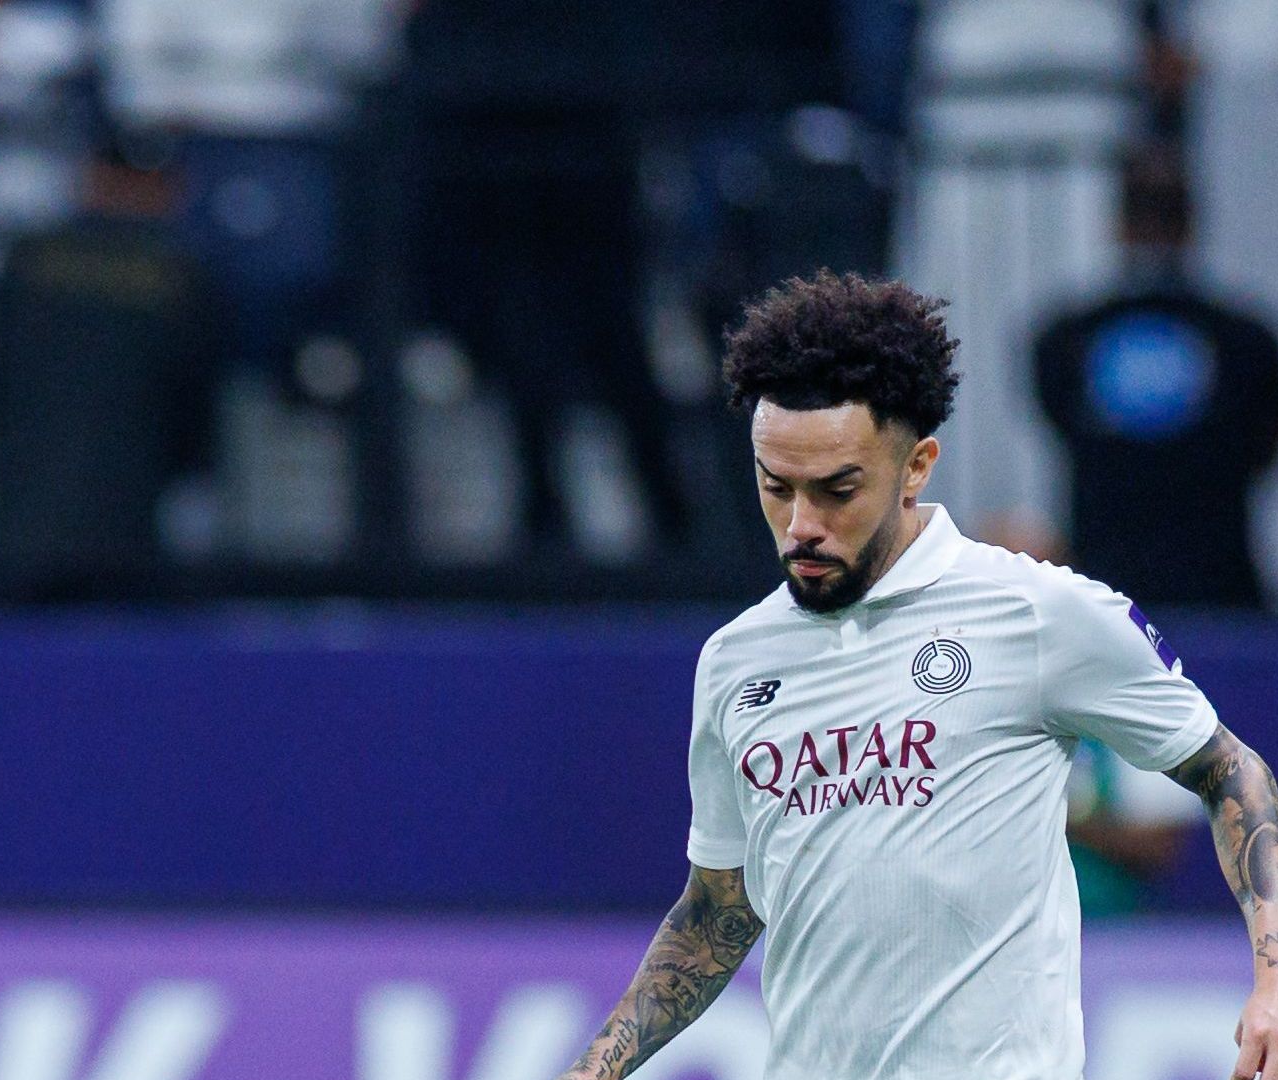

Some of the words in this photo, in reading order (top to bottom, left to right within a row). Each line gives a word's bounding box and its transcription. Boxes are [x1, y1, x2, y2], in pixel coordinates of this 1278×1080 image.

[741, 719, 938, 799] QATAR
[784, 774, 936, 817] AIRWAYS
[602, 1017, 639, 1077] Faith
